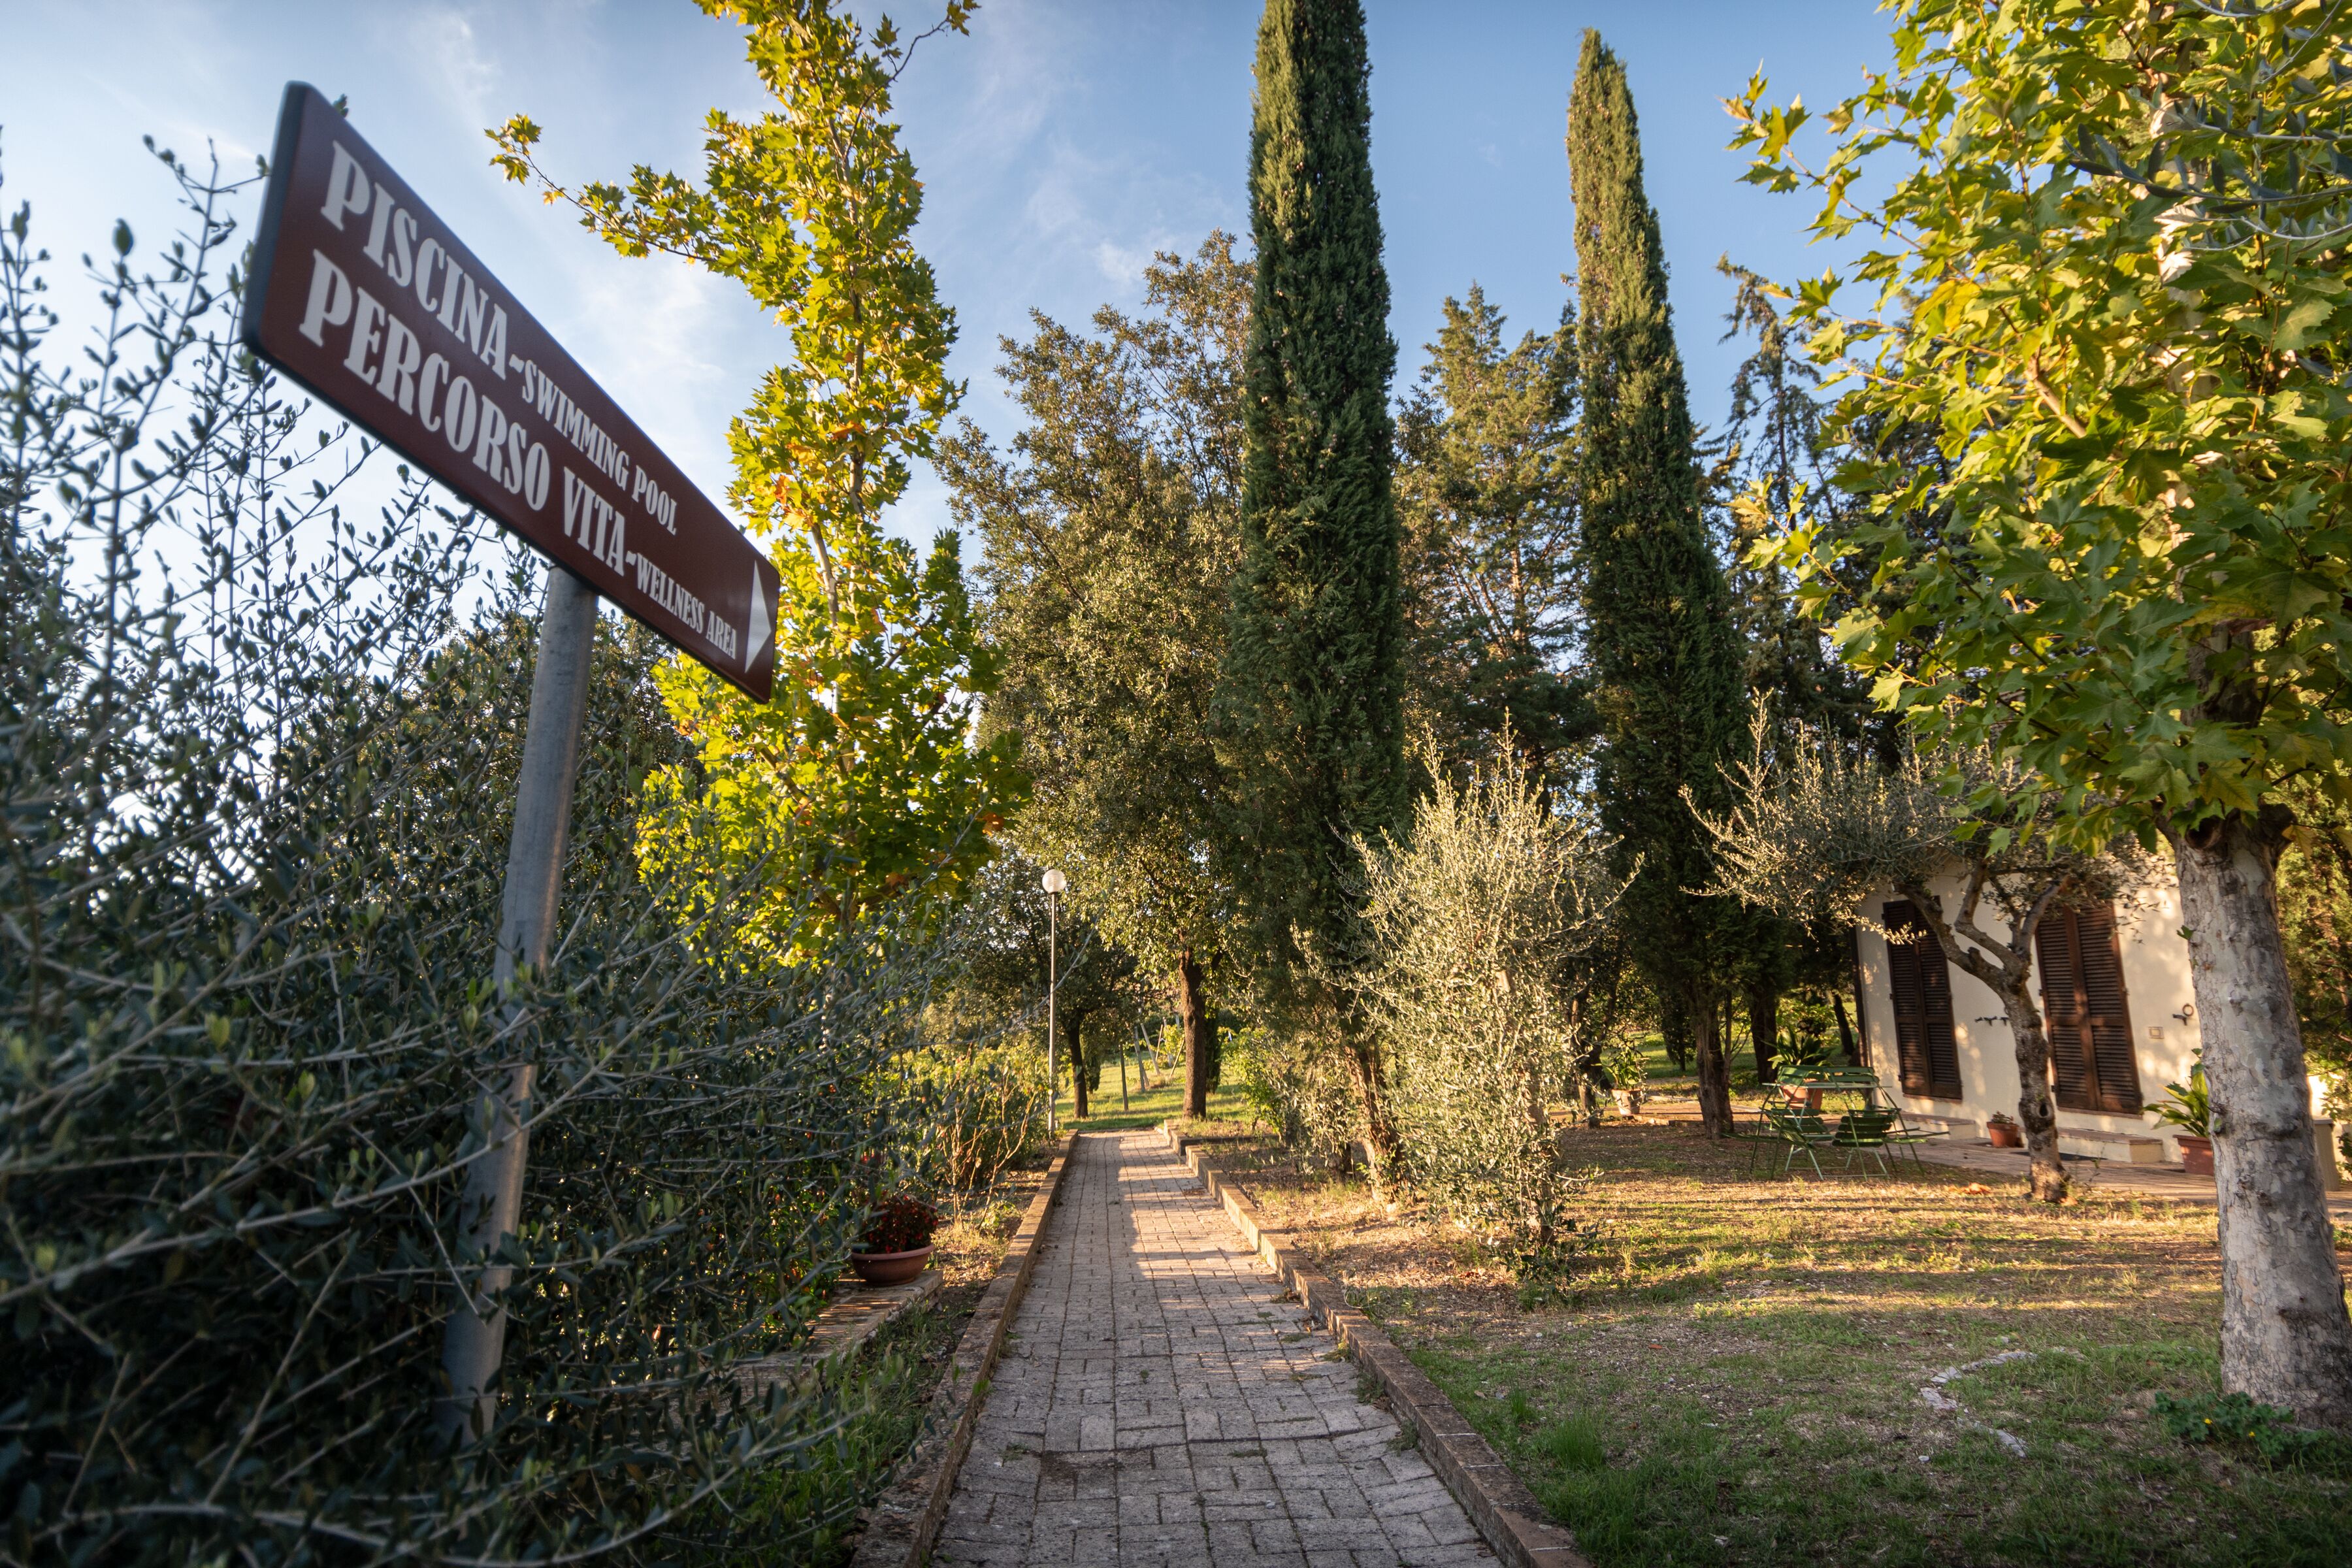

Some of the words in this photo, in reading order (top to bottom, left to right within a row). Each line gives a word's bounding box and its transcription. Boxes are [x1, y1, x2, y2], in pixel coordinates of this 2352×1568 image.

[299, 248, 551, 511] PERCORSO
[706, 610, 737, 660] AREA
[631, 465, 677, 536] POOL
